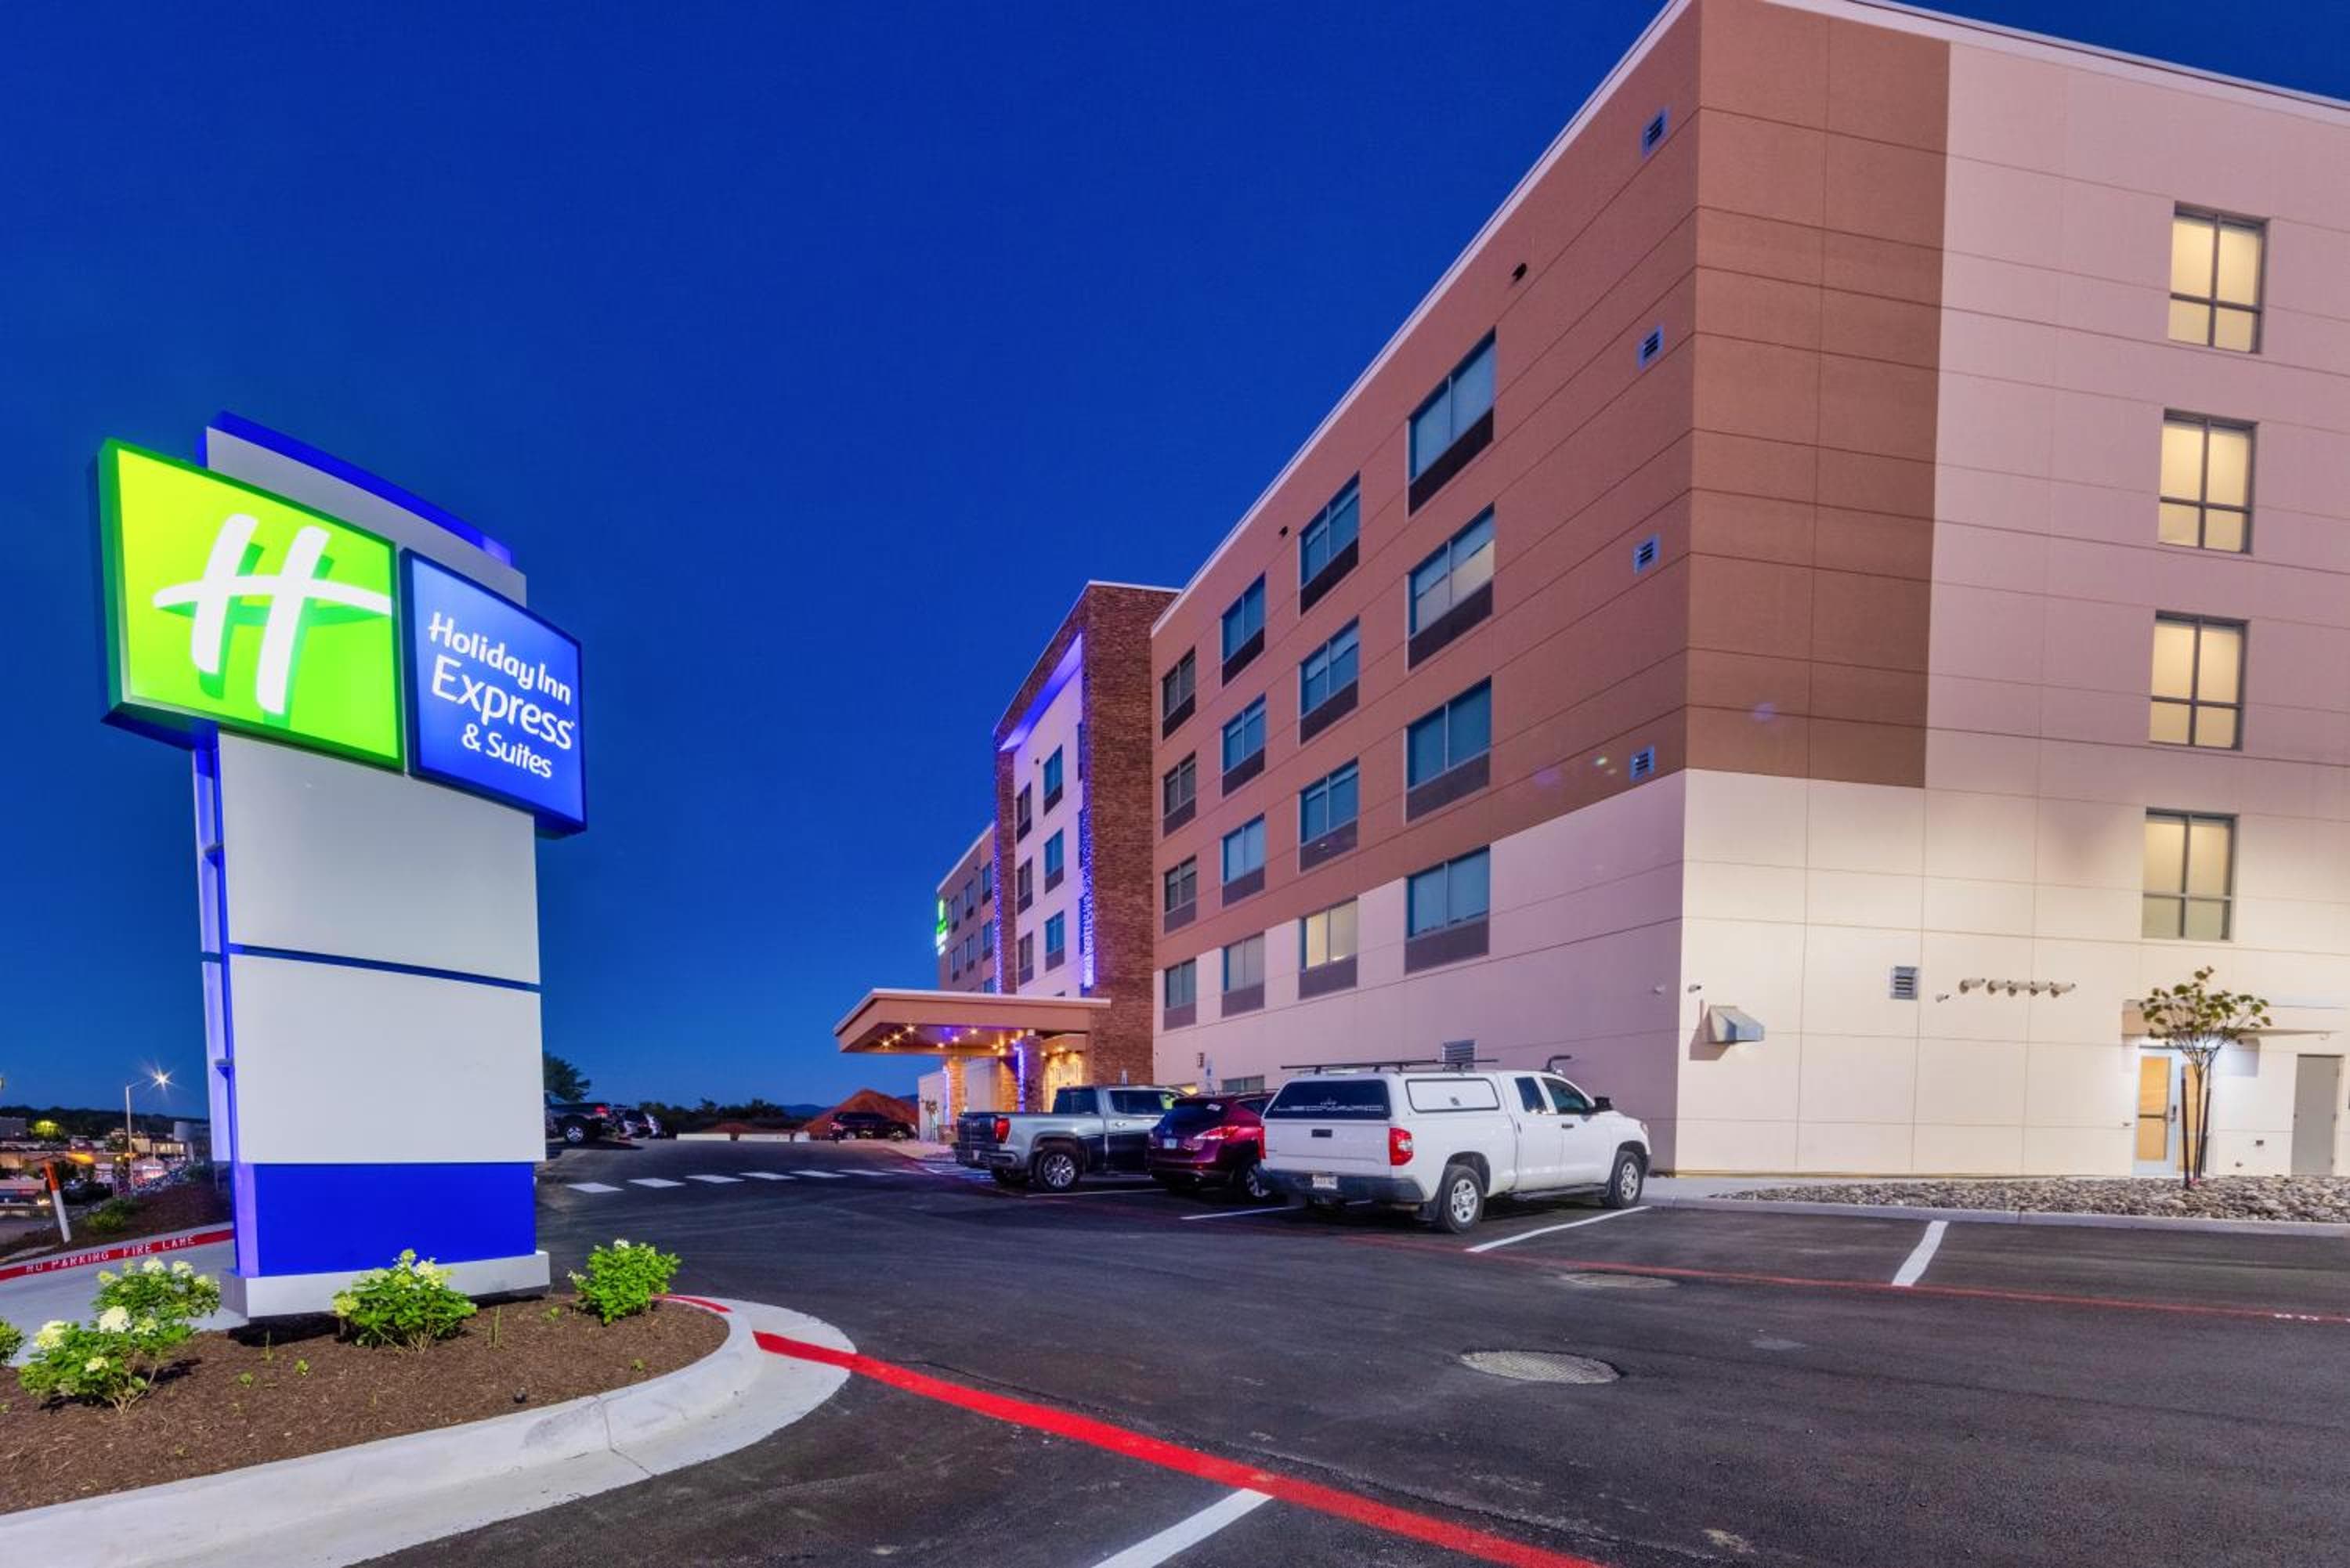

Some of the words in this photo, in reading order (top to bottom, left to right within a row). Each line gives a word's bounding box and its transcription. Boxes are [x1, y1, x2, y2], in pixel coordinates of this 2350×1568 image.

[428, 611, 535, 690] Holiday
[537, 663, 571, 706] Inn
[432, 654, 576, 750] Express
[461, 724, 481, 751] &
[486, 732, 552, 778] Suites
[27, 1263, 43, 1274] NO
[51, 1253, 109, 1270] PARKING
[123, 1244, 151, 1257] FIRE
[162, 1237, 195, 1250] LANE
